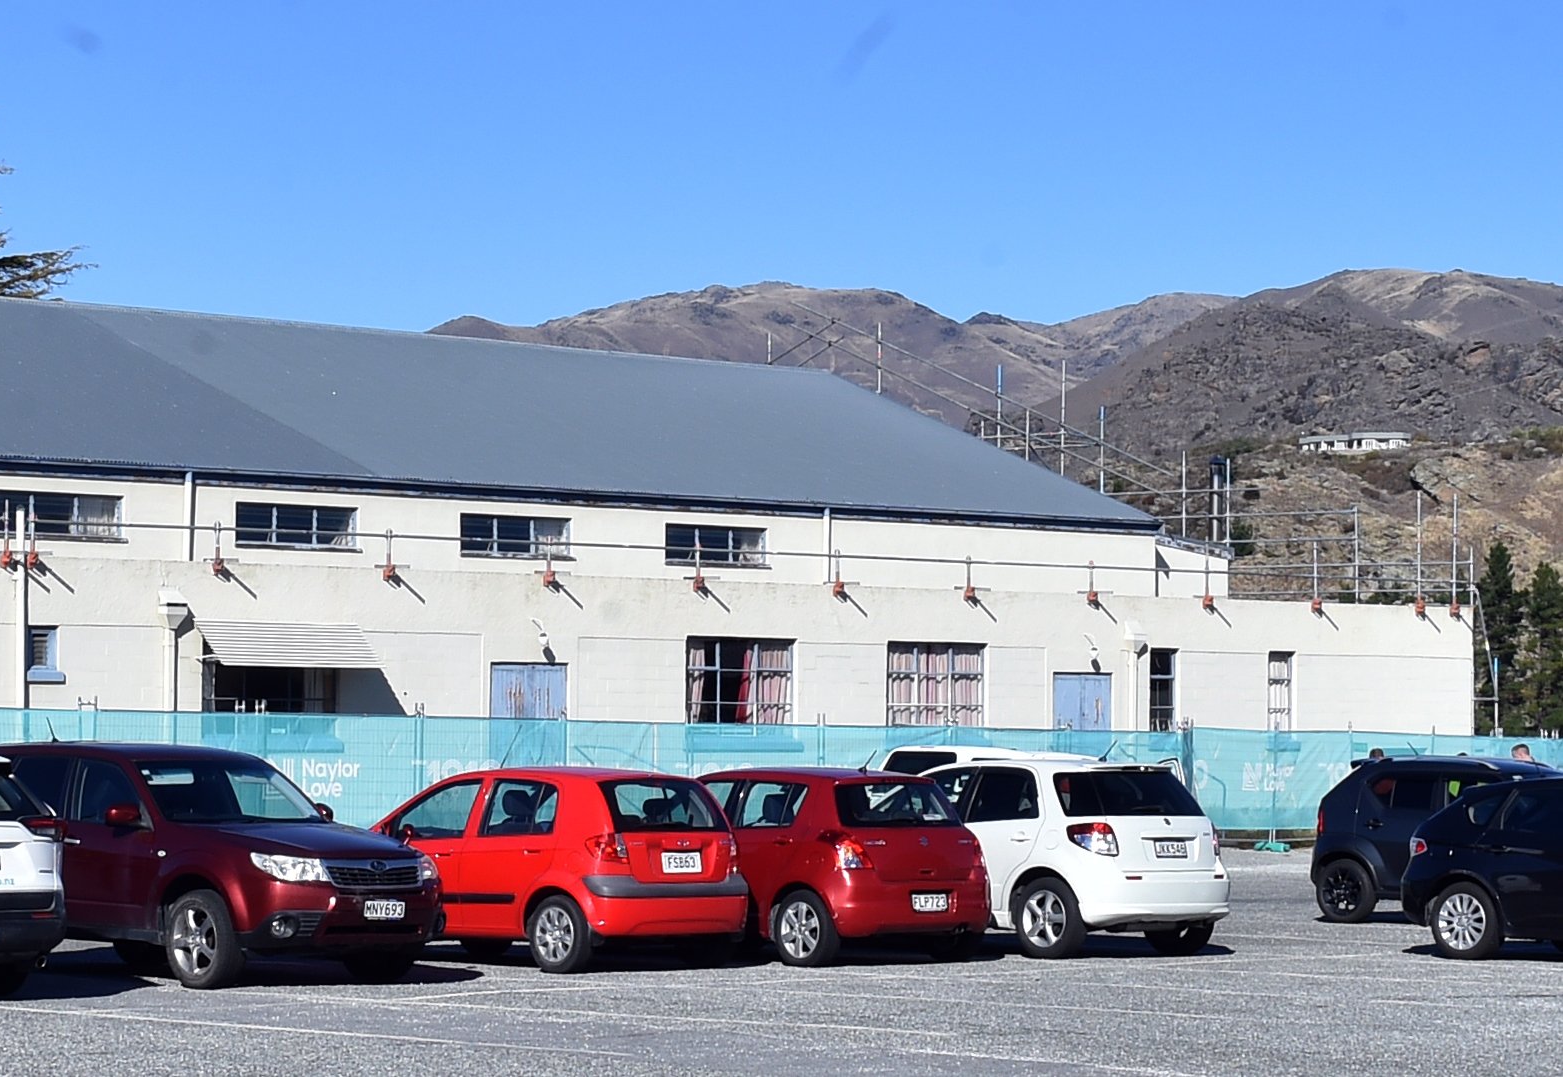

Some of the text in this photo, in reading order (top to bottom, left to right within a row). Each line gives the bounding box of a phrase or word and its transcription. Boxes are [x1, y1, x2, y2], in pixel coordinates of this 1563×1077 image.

[302, 758, 360, 782] Naylor
[302, 782, 343, 797] Love
[667, 856, 696, 869] FSB63
[364, 901, 405, 916] MNY693
[913, 895, 946, 908] FLP723
